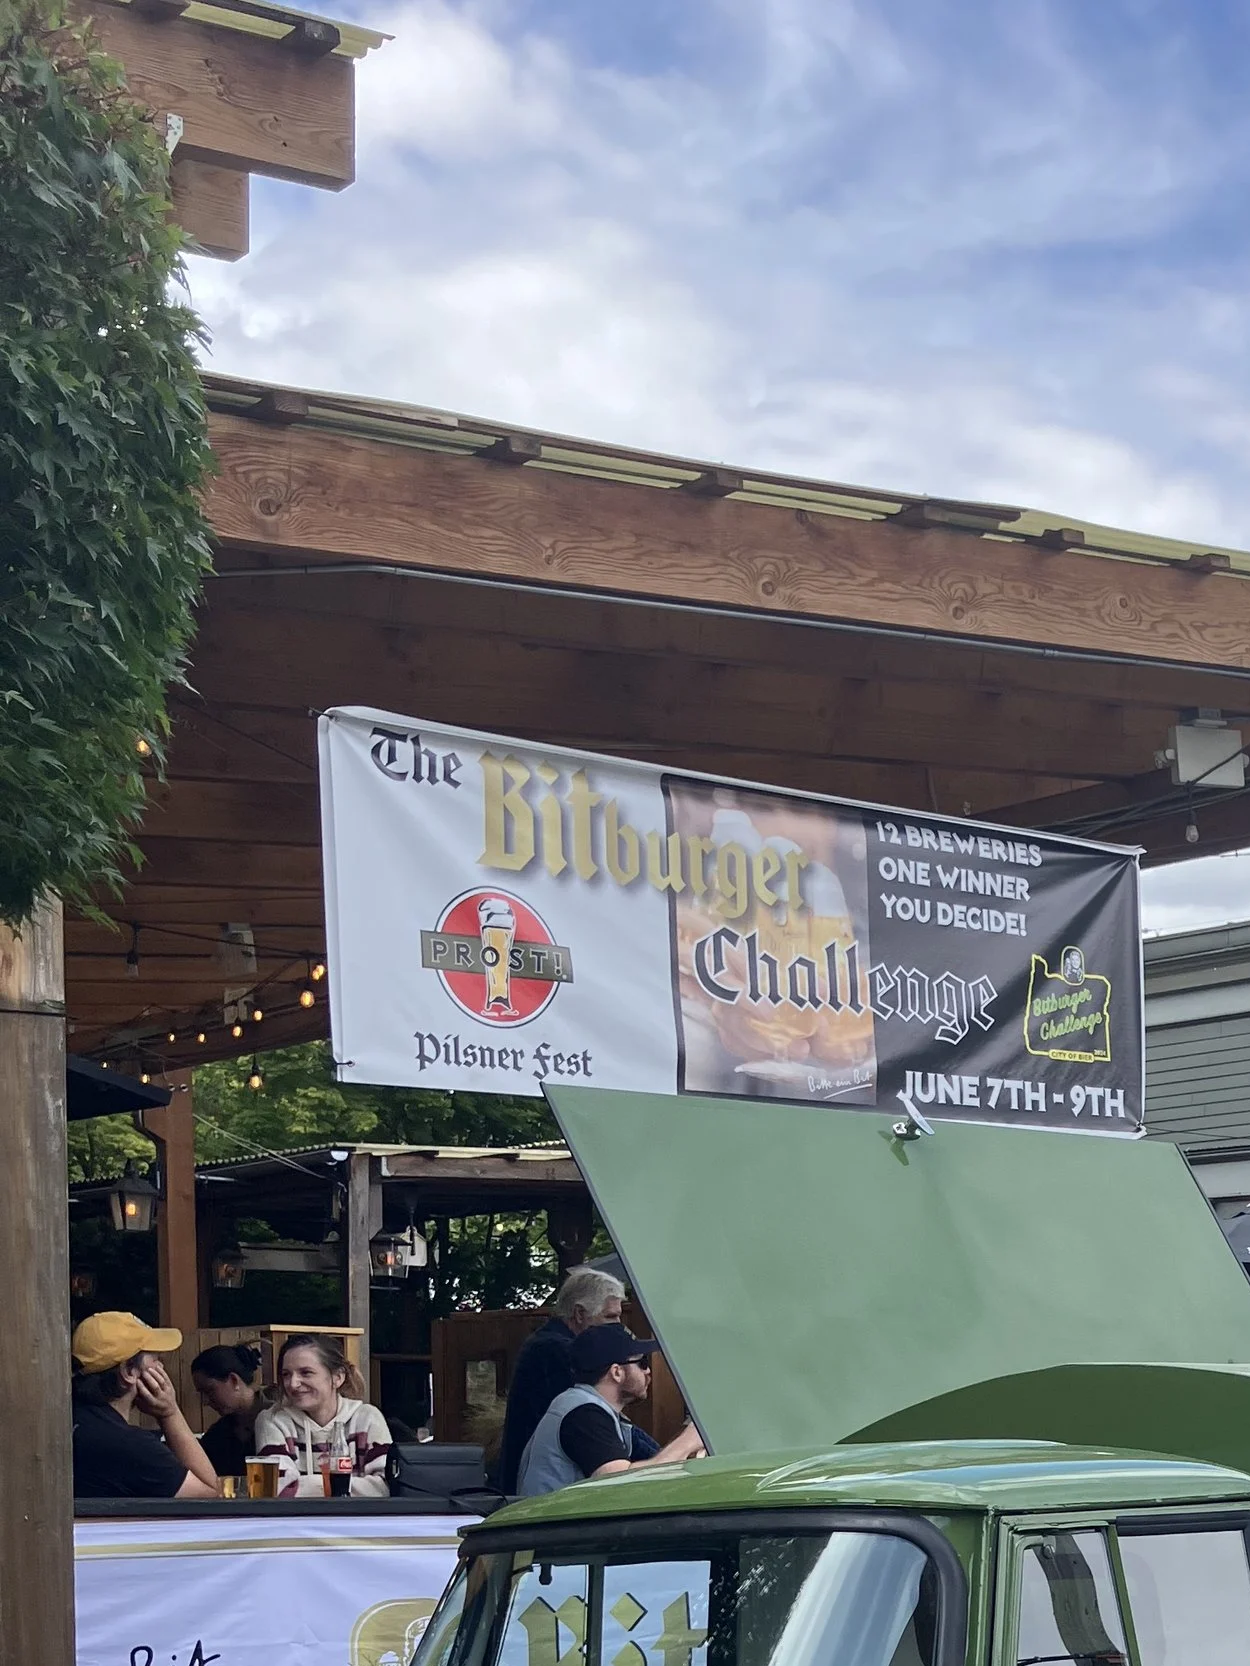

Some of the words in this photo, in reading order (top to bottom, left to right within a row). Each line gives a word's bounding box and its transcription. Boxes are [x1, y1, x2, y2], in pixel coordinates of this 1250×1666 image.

[370, 727, 463, 789] The
[475, 750, 810, 920] Bitburger
[876, 821, 902, 845] 12
[904, 824, 1043, 868] BREWERIES
[878, 856, 931, 887] ONE
[935, 864, 1031, 902] WINNER
[880, 892, 931, 924] YOU
[936, 901, 1028, 937] DECIDE!
[430, 938, 563, 977] PROST!
[693, 926, 998, 1045] Challenge
[1033, 988, 1092, 1017] Bitburger
[1040, 1012, 1102, 1040] Challenge
[414, 1031, 525, 1072] Pilsner
[532, 1042, 593, 1080] Fest
[901, 1070, 981, 1108] JUNE
[986, 1076, 1047, 1113] 7TH
[1053, 1092, 1064, 1104] -
[1069, 1085, 1125, 1118] 9TH
